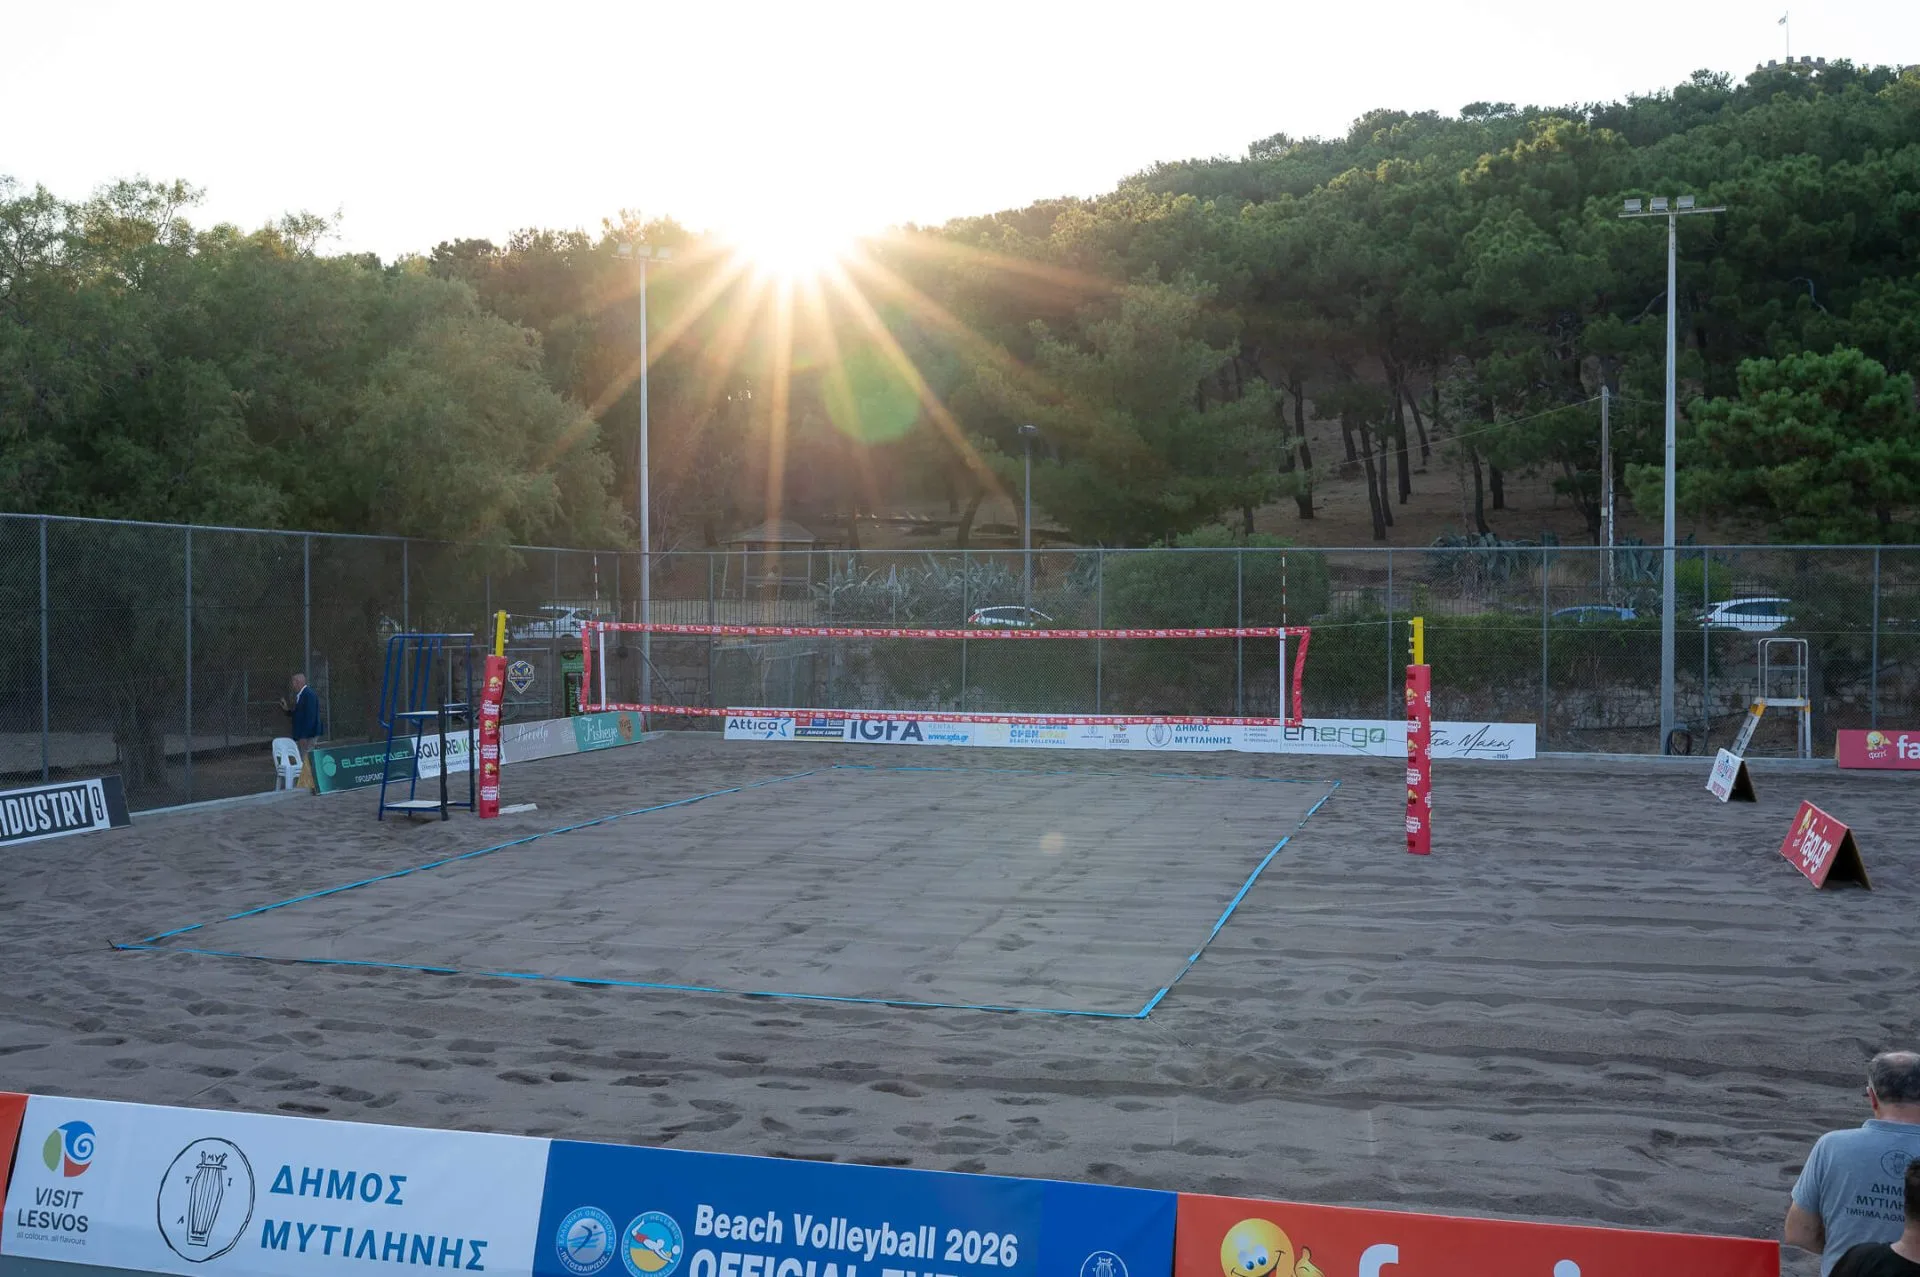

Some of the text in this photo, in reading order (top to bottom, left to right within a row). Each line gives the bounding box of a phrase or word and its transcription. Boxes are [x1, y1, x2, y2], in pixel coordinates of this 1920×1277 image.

[728, 719, 778, 730] Attica
[850, 720, 924, 741] IGFA
[1175, 724, 1210, 732] ΔΗΜΟΣ
[417, 739, 457, 760] SQURE
[1174, 736, 1232, 744] ΜΥΤΙΛΗΝΗΣ
[269, 1164, 408, 1206] ΔΗΜΟΣ
[35, 1187, 84, 1209] VISIT
[17, 1208, 89, 1233] LESVOS
[260, 1219, 489, 1272] ΜΥΤΙΛΗΝΗΣ
[694, 1204, 1018, 1268] Beach Volleyball 2026
